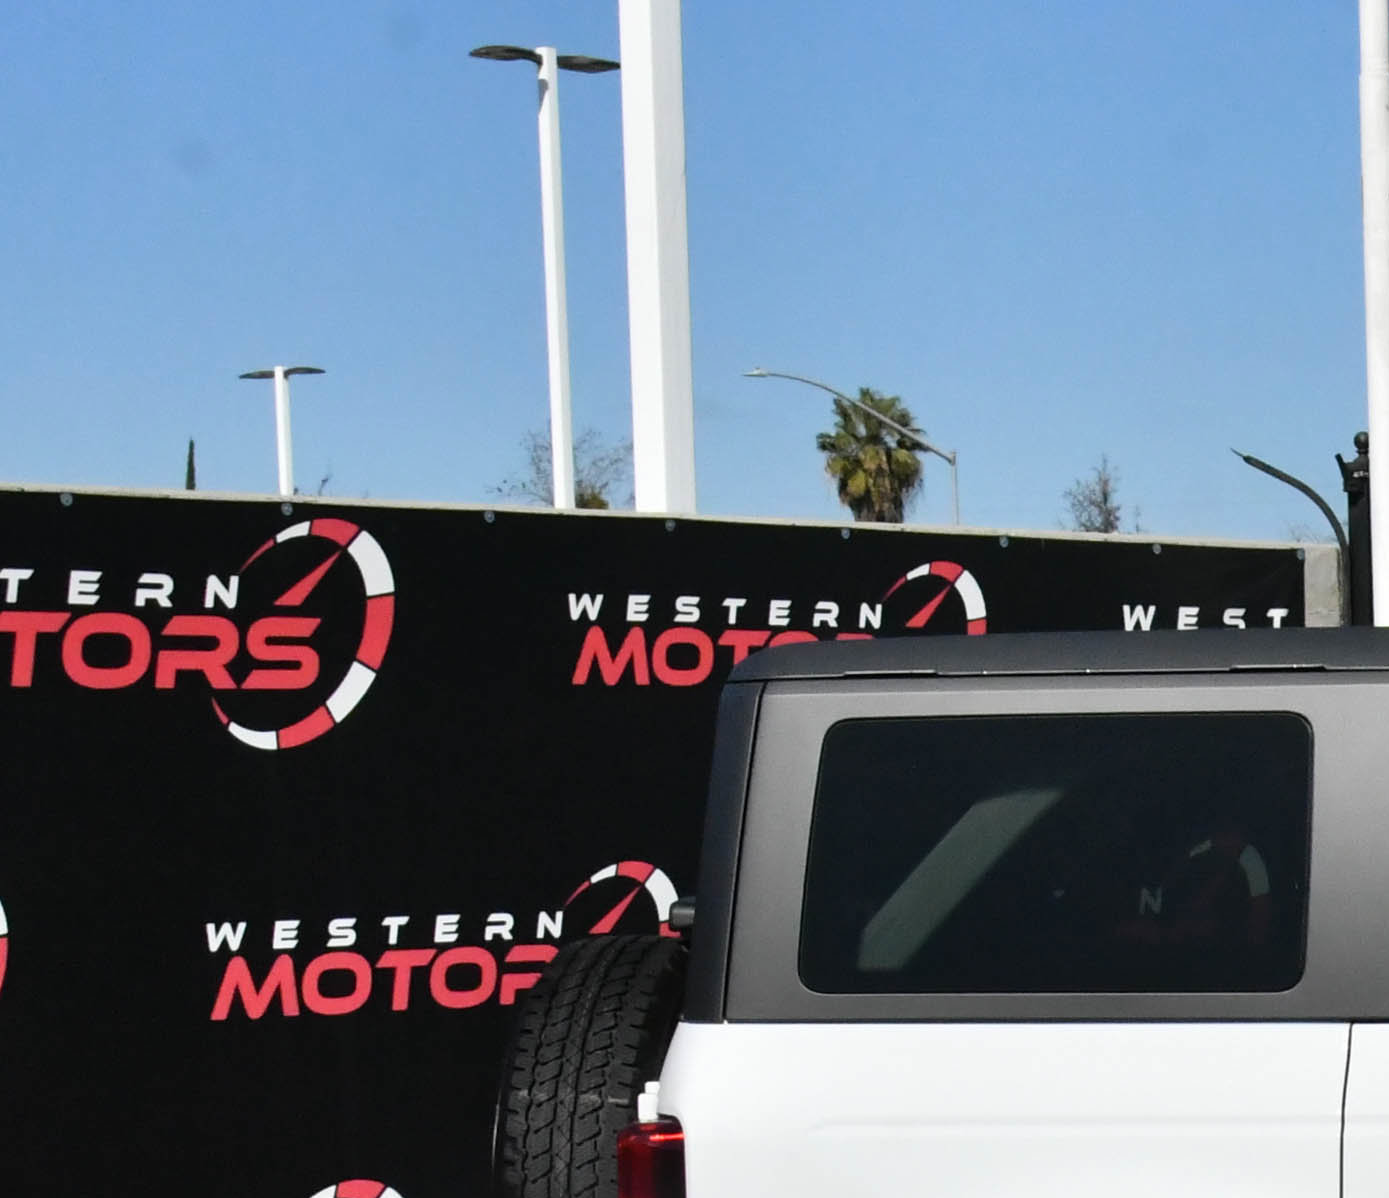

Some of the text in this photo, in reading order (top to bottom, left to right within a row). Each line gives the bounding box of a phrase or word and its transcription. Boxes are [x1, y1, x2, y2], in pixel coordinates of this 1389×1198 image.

[0, 568, 239, 608] TERN
[568, 593, 882, 630] WESTERN
[1122, 604, 1289, 632] WEST
[0, 611, 322, 689] TORS
[572, 625, 878, 687] MOT
[206, 911, 564, 952] WESTERN
